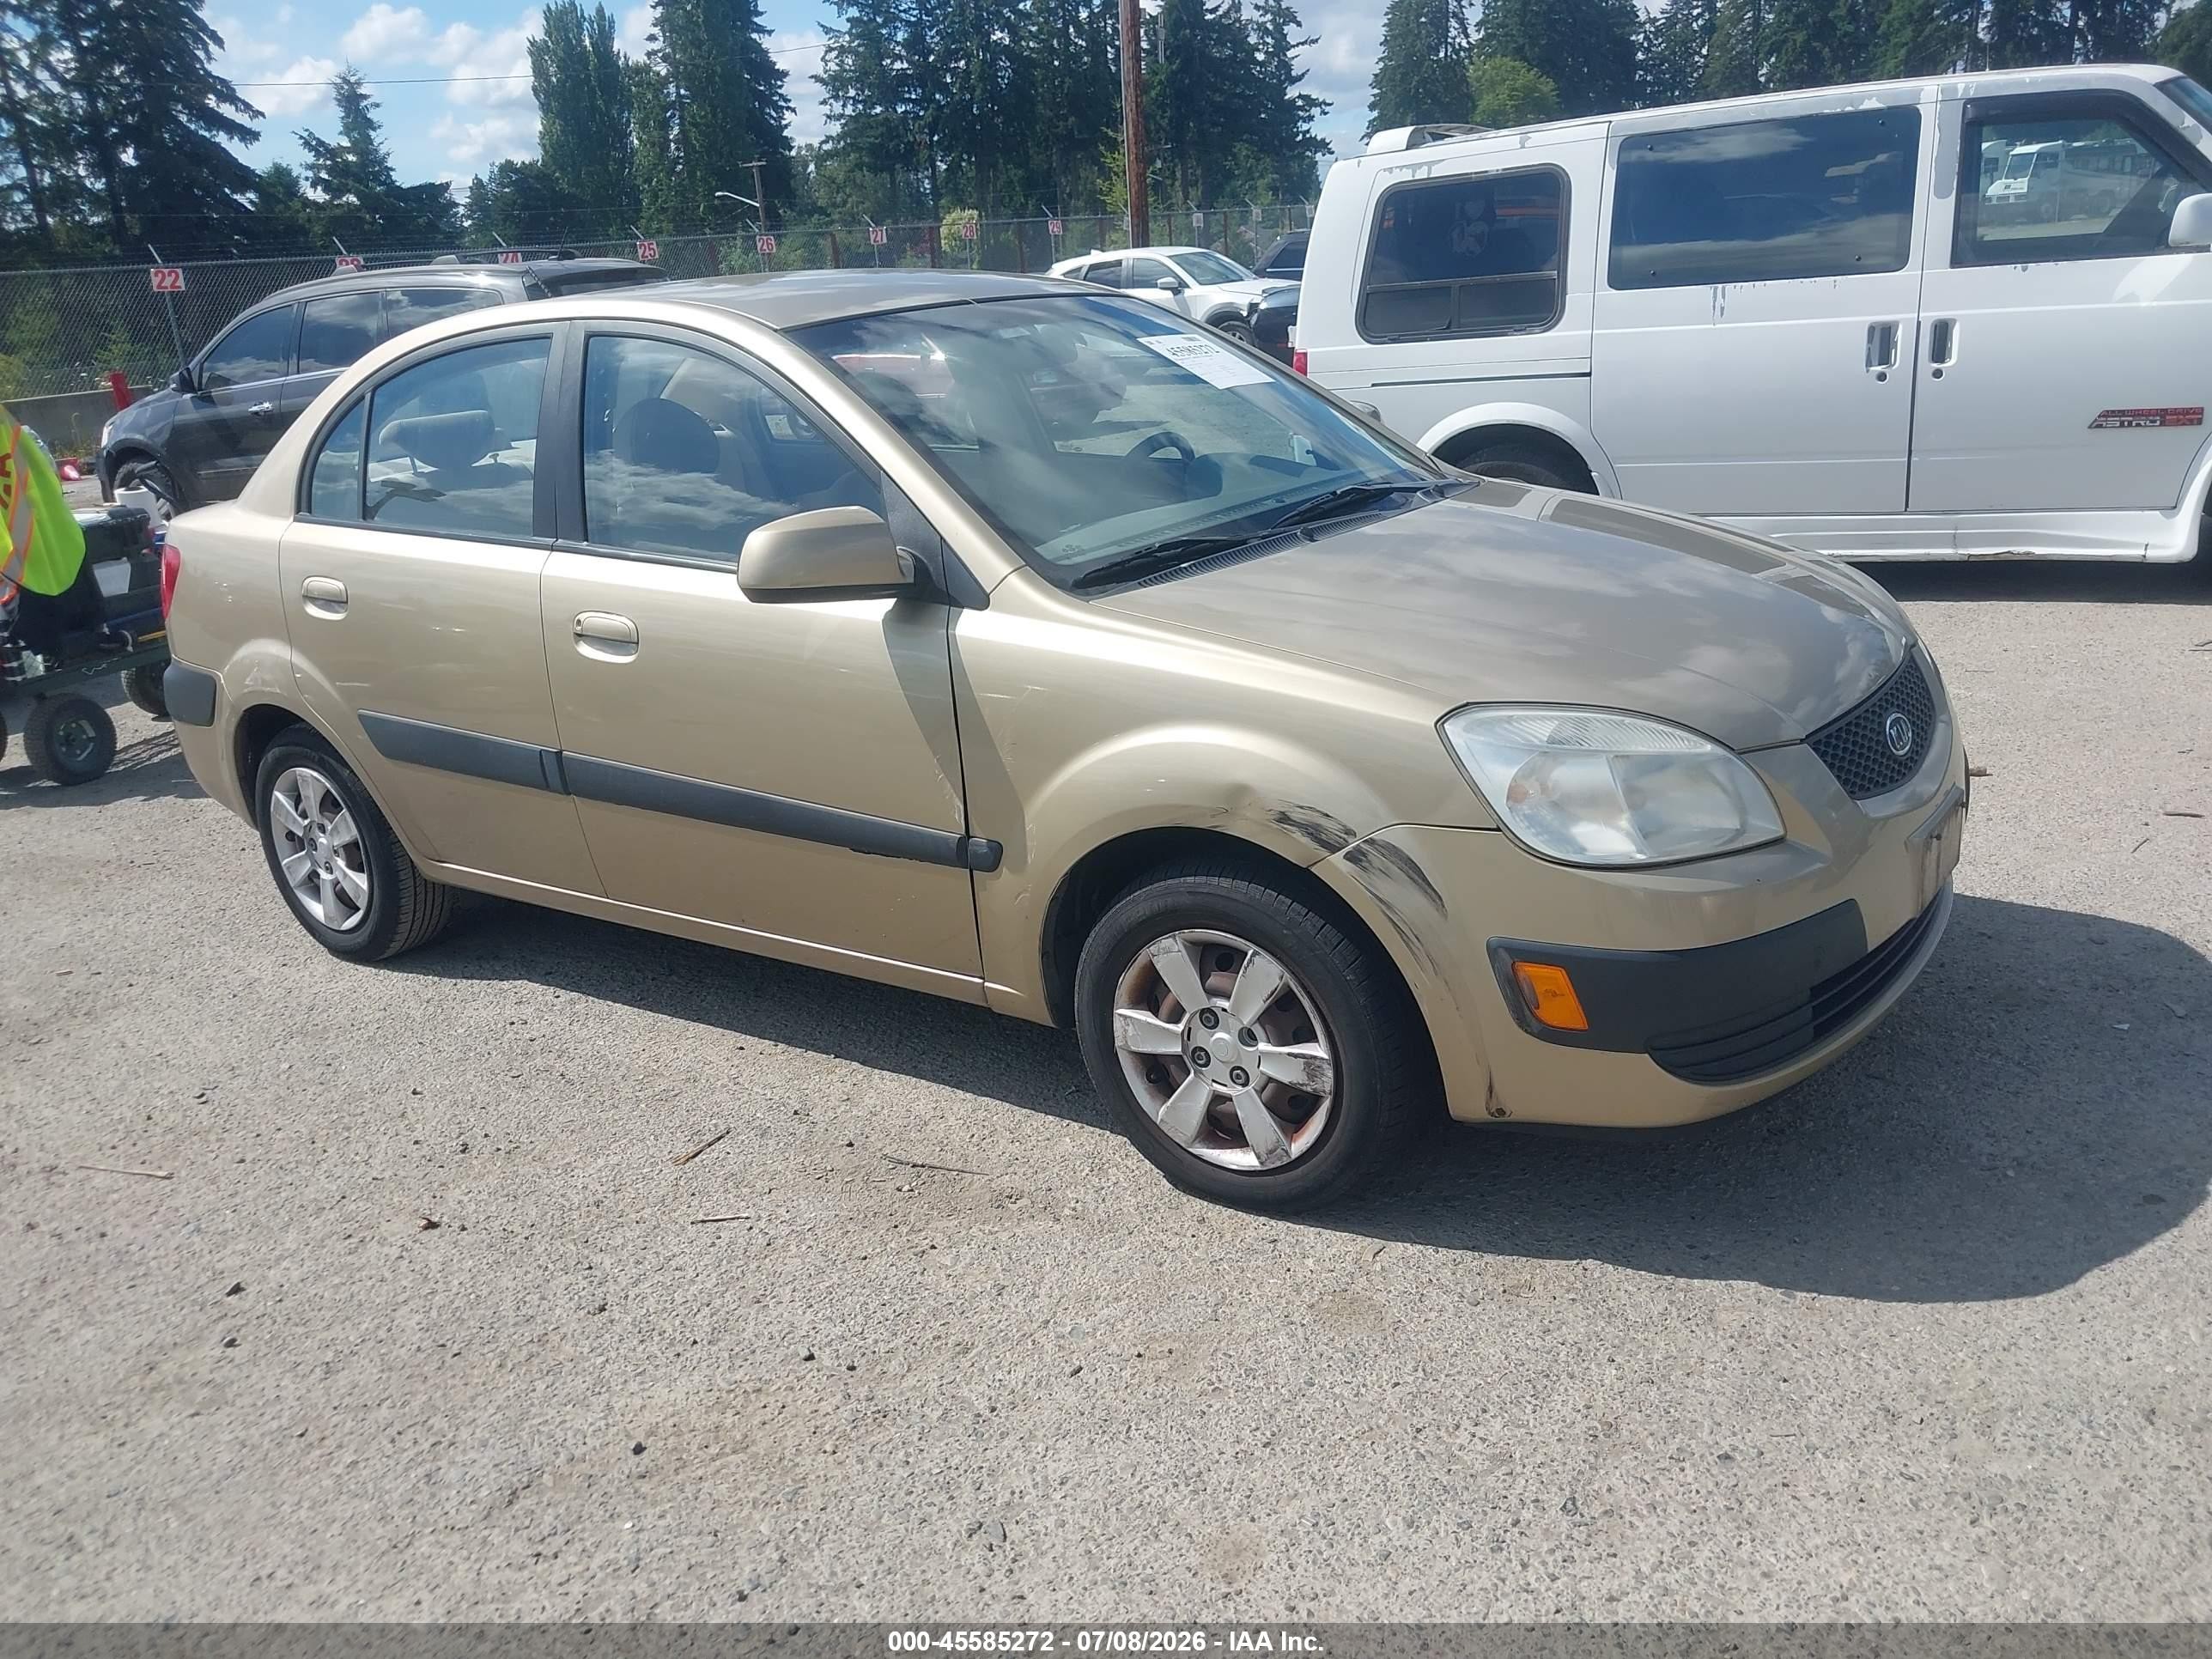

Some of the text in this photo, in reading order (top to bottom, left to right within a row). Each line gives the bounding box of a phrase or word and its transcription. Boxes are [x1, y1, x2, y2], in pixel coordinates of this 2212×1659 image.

[872, 228, 884, 243] 27
[963, 225, 975, 238] 28
[639, 242, 656, 259] 25
[758, 237, 774, 252] 26
[154, 269, 182, 289] 22
[2091, 416, 2160, 428] ASTRO
